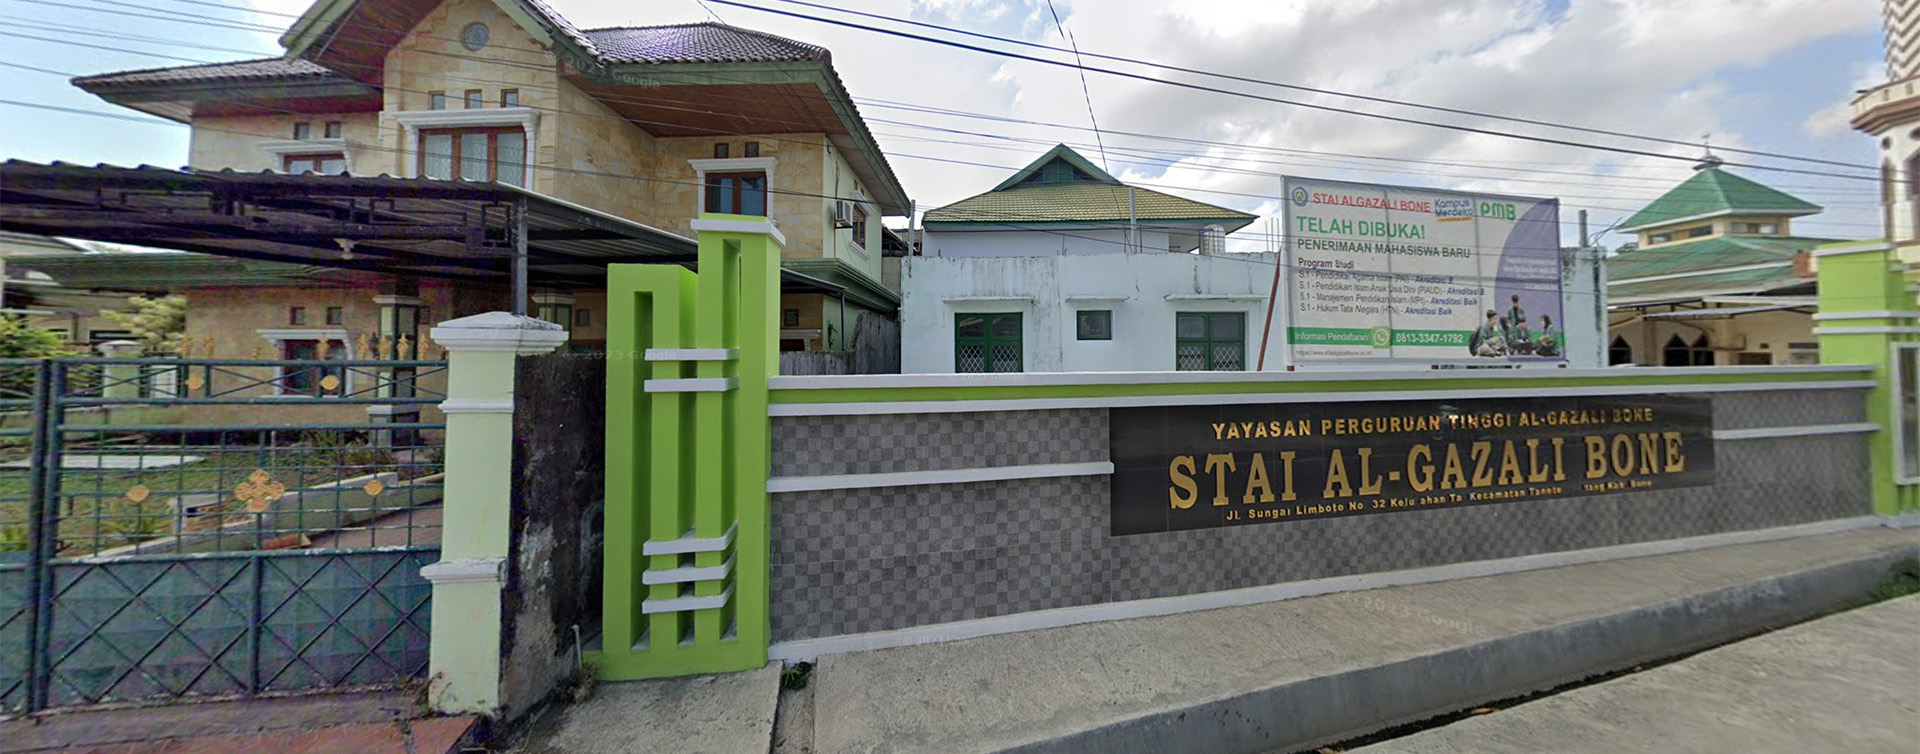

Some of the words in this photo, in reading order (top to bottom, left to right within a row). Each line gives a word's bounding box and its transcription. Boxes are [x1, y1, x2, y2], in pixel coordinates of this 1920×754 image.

[1313, 193, 1338, 205] STAI
[1400, 200, 1430, 212] BONE
[1434, 198, 1469, 208] Kampus
[1480, 202, 1516, 221] PMB
[1296, 215, 1353, 235] TELAH
[1358, 220, 1426, 239] DIBUKA!
[1297, 238, 1373, 253] PENERIMAAN
[1375, 243, 1439, 257] MAHASISWA
[1442, 246, 1471, 258] BARU
[1298, 258, 1333, 269] Program
[1335, 260, 1354, 269] Studi
[1316, 282, 1352, 291] Pendidikan
[1355, 305, 1379, 315] Negara
[1295, 332, 1326, 341] Informasi
[1396, 332, 1464, 344] 0813-3347-1792
[1211, 420, 1311, 440] YAYASAN
[1321, 415, 1440, 436] PERGURUAN
[1448, 413, 1511, 430] TINGGI
[1519, 410, 1606, 427] AL-GAZALI
[1613, 408, 1654, 424] BONE
[1168, 450, 1297, 509] STAI
[1322, 437, 1567, 499] AL-GAZALI
[1584, 431, 1685, 479] BONE
[1248, 508, 1291, 519] Sungai
[1296, 503, 1344, 515] Limboto
[1372, 499, 1385, 509] 32
[1469, 489, 1526, 501] Kecamatan
